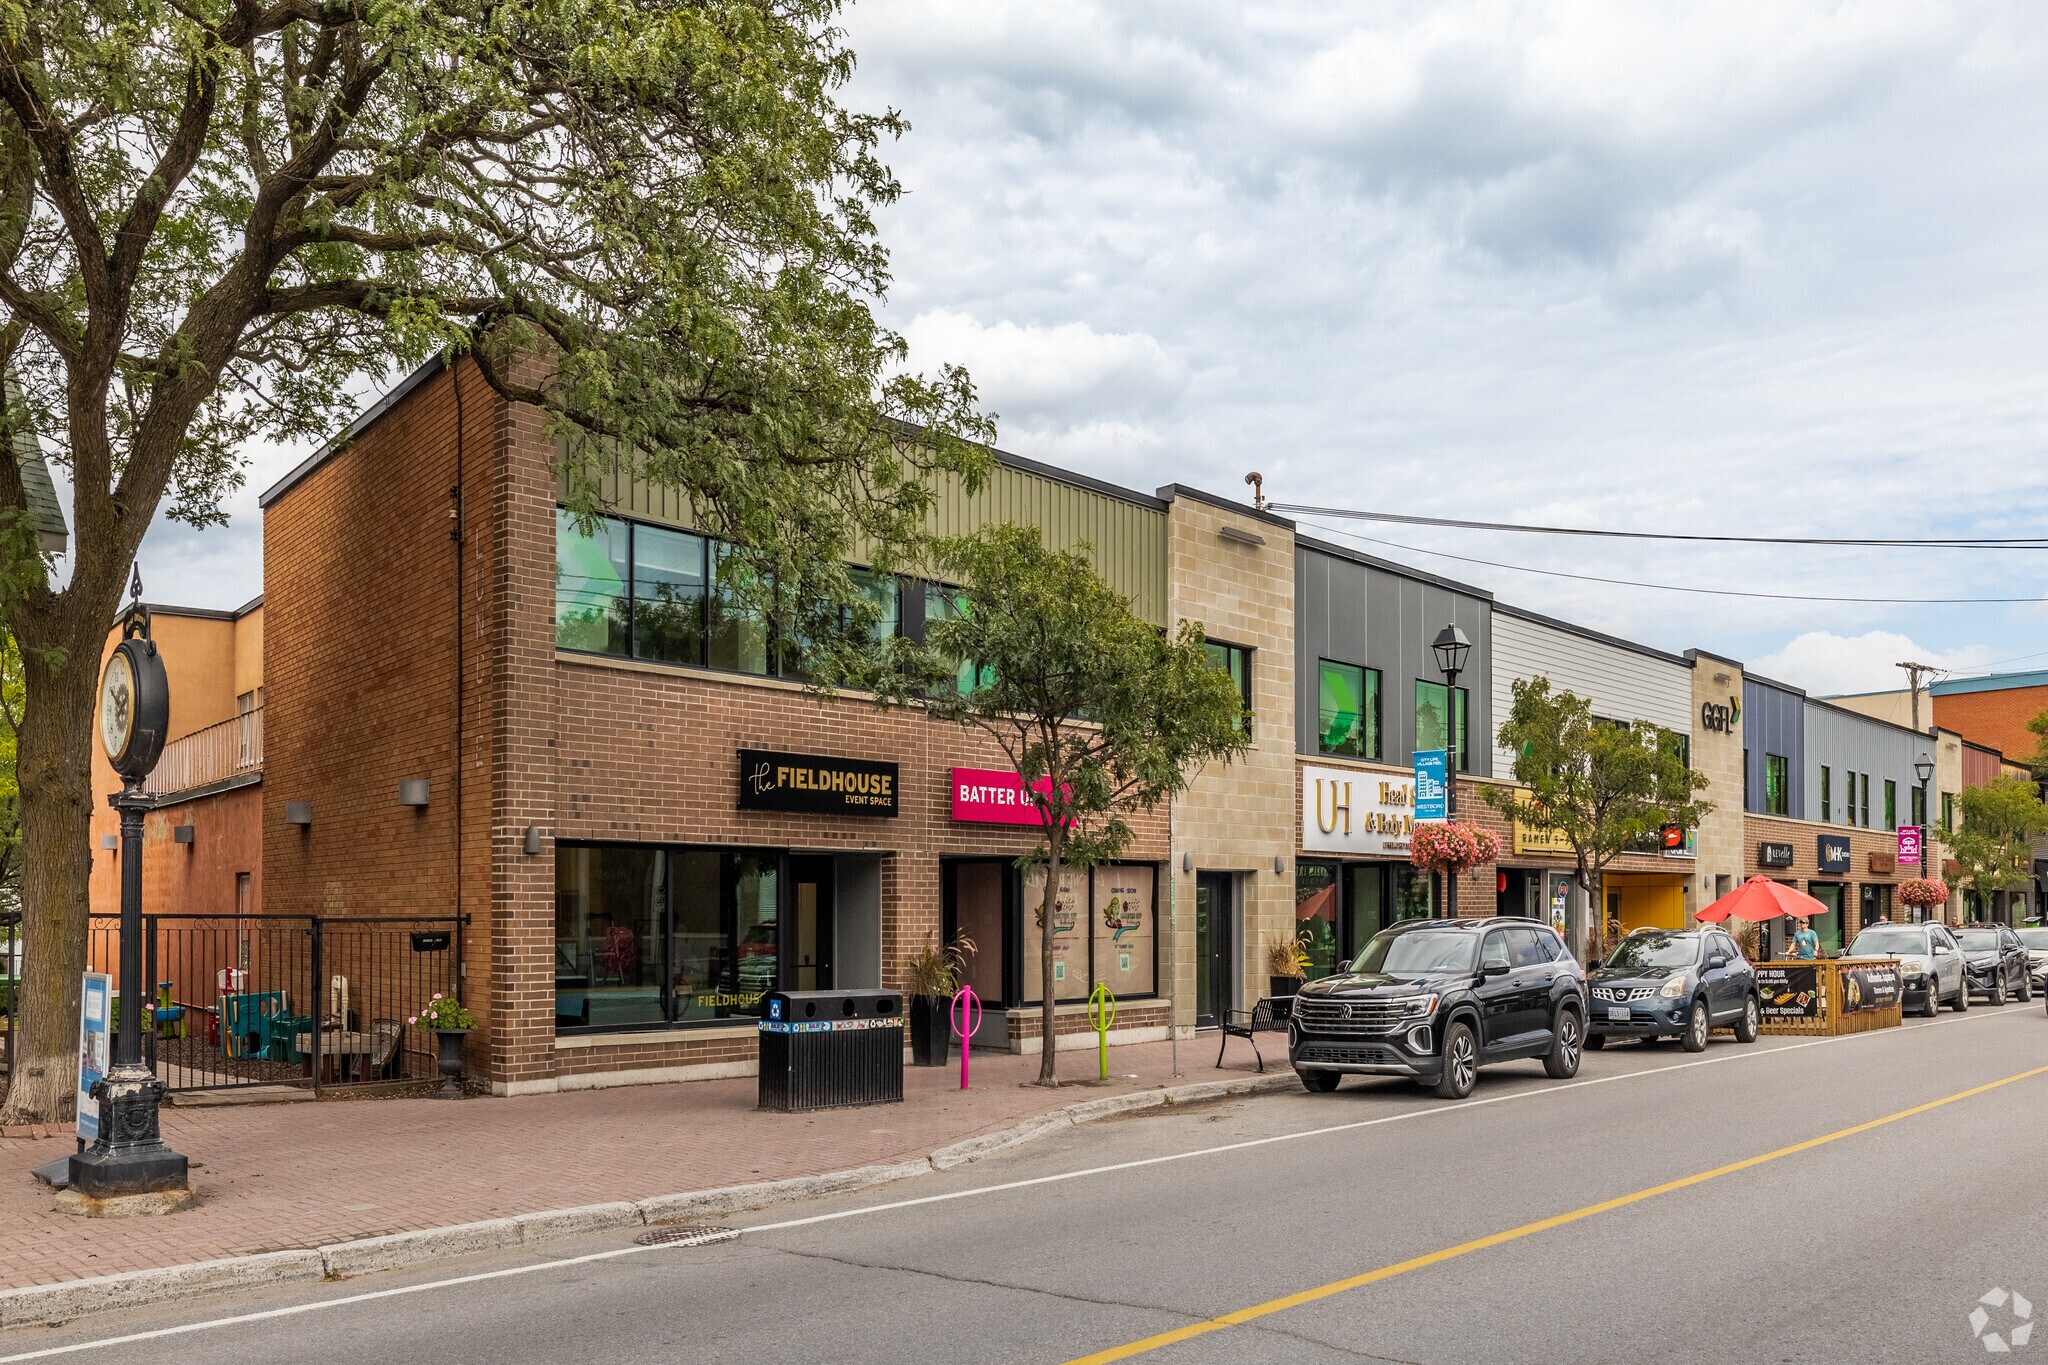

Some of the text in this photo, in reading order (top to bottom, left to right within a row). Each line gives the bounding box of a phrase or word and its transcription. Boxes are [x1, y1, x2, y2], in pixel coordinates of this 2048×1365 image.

[748, 762, 892, 795] the FIELDHOUSE
[845, 795, 892, 806] EVENT SPACE
[960, 784, 1015, 805] BATTER
[1379, 781, 1408, 806] Head
[1365, 811, 1376, 833] &
[1377, 812, 1402, 839] Body
[1522, 834, 1550, 844] RAMEN
[698, 994, 762, 1007] FIELDHOUS
[1780, 1007, 1804, 1015] Specials
